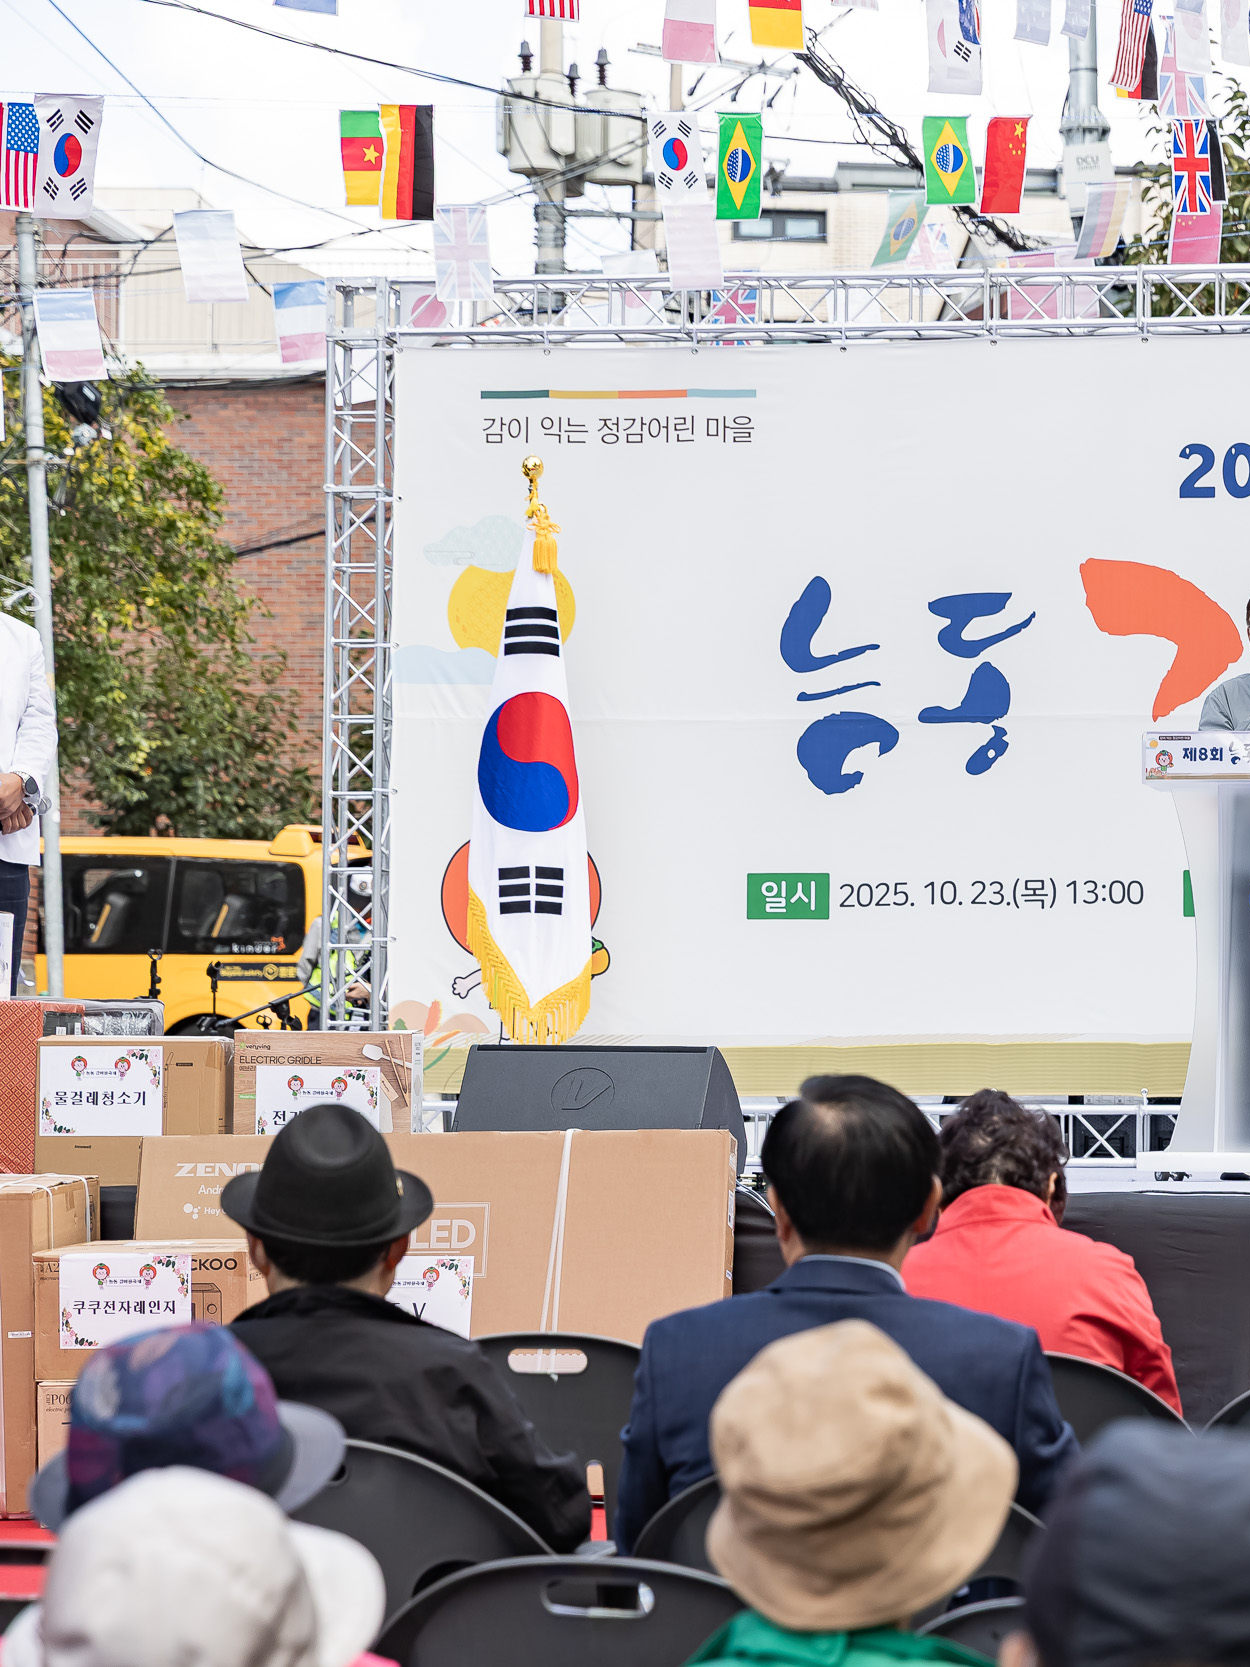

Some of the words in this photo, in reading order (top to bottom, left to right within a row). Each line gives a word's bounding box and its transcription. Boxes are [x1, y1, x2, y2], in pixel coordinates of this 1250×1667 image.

[482, 416, 529, 443] 감이
[540, 416, 589, 443] 익는
[597, 415, 695, 444] 정감어린
[706, 415, 755, 443] 마을
[779, 575, 1036, 796] 능동
[1182, 746, 1223, 762] 제8회
[760, 880, 816, 913] 일시
[838, 882, 916, 908] 2025.
[924, 880, 964, 907] 10.
[970, 877, 1058, 911] 23.(목)
[1065, 879, 1145, 905] 13:00
[239, 1055, 286, 1064] ELECTRIC
[287, 1055, 322, 1065] GRIDLE
[54, 1090, 147, 1106] 물걸레청소기
[204, 1207, 220, 1217] Hey
[72, 1299, 177, 1315] 쿠쿠전자레인지
